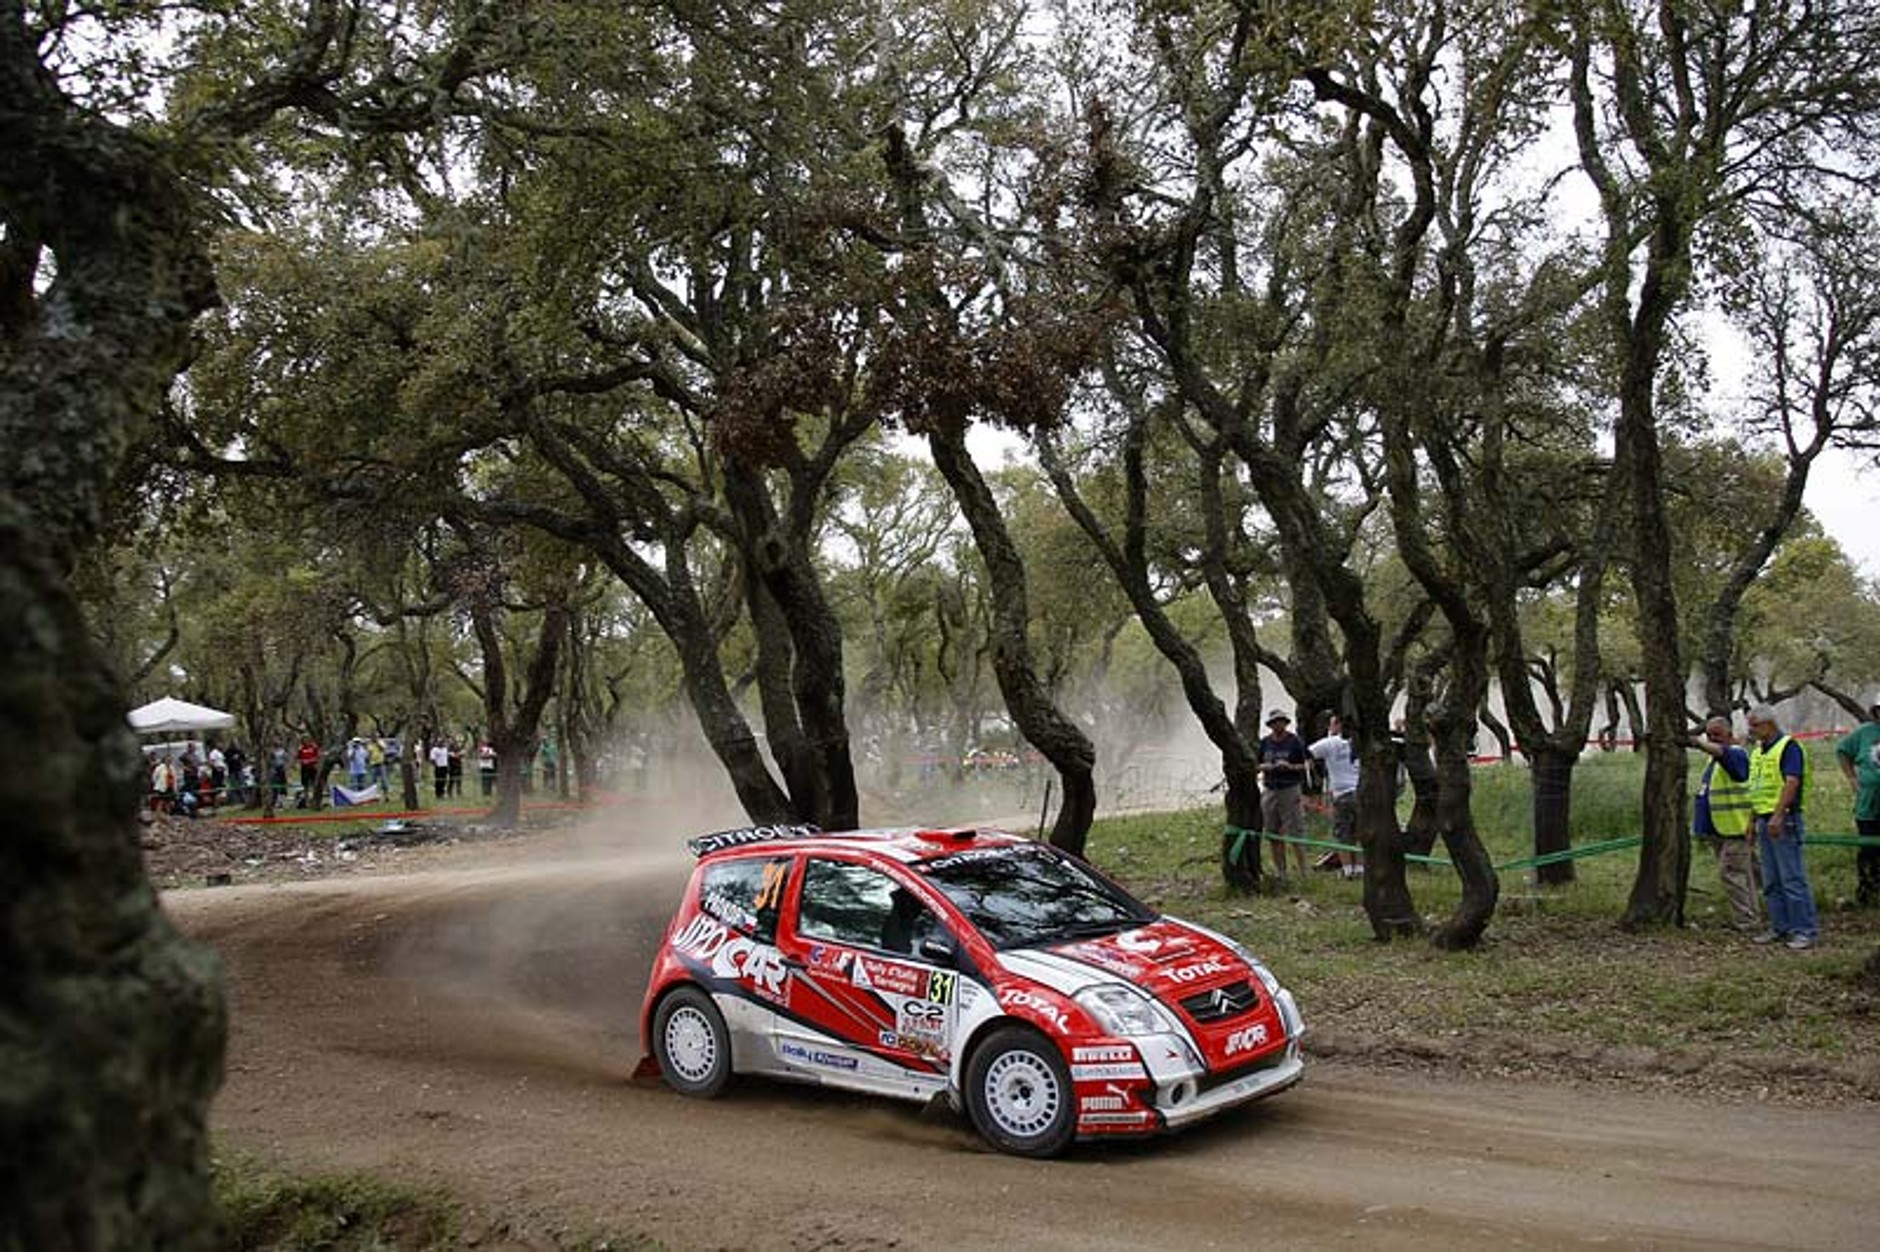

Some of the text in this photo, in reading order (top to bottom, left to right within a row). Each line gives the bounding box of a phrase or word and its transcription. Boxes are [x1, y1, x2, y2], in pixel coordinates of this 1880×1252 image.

[753, 862, 787, 909] 31
[1159, 954, 1232, 983] TOTAL
[930, 972, 956, 1006] 31
[903, 1000, 944, 1022] C2
[998, 988, 1069, 1035] TOTAL
